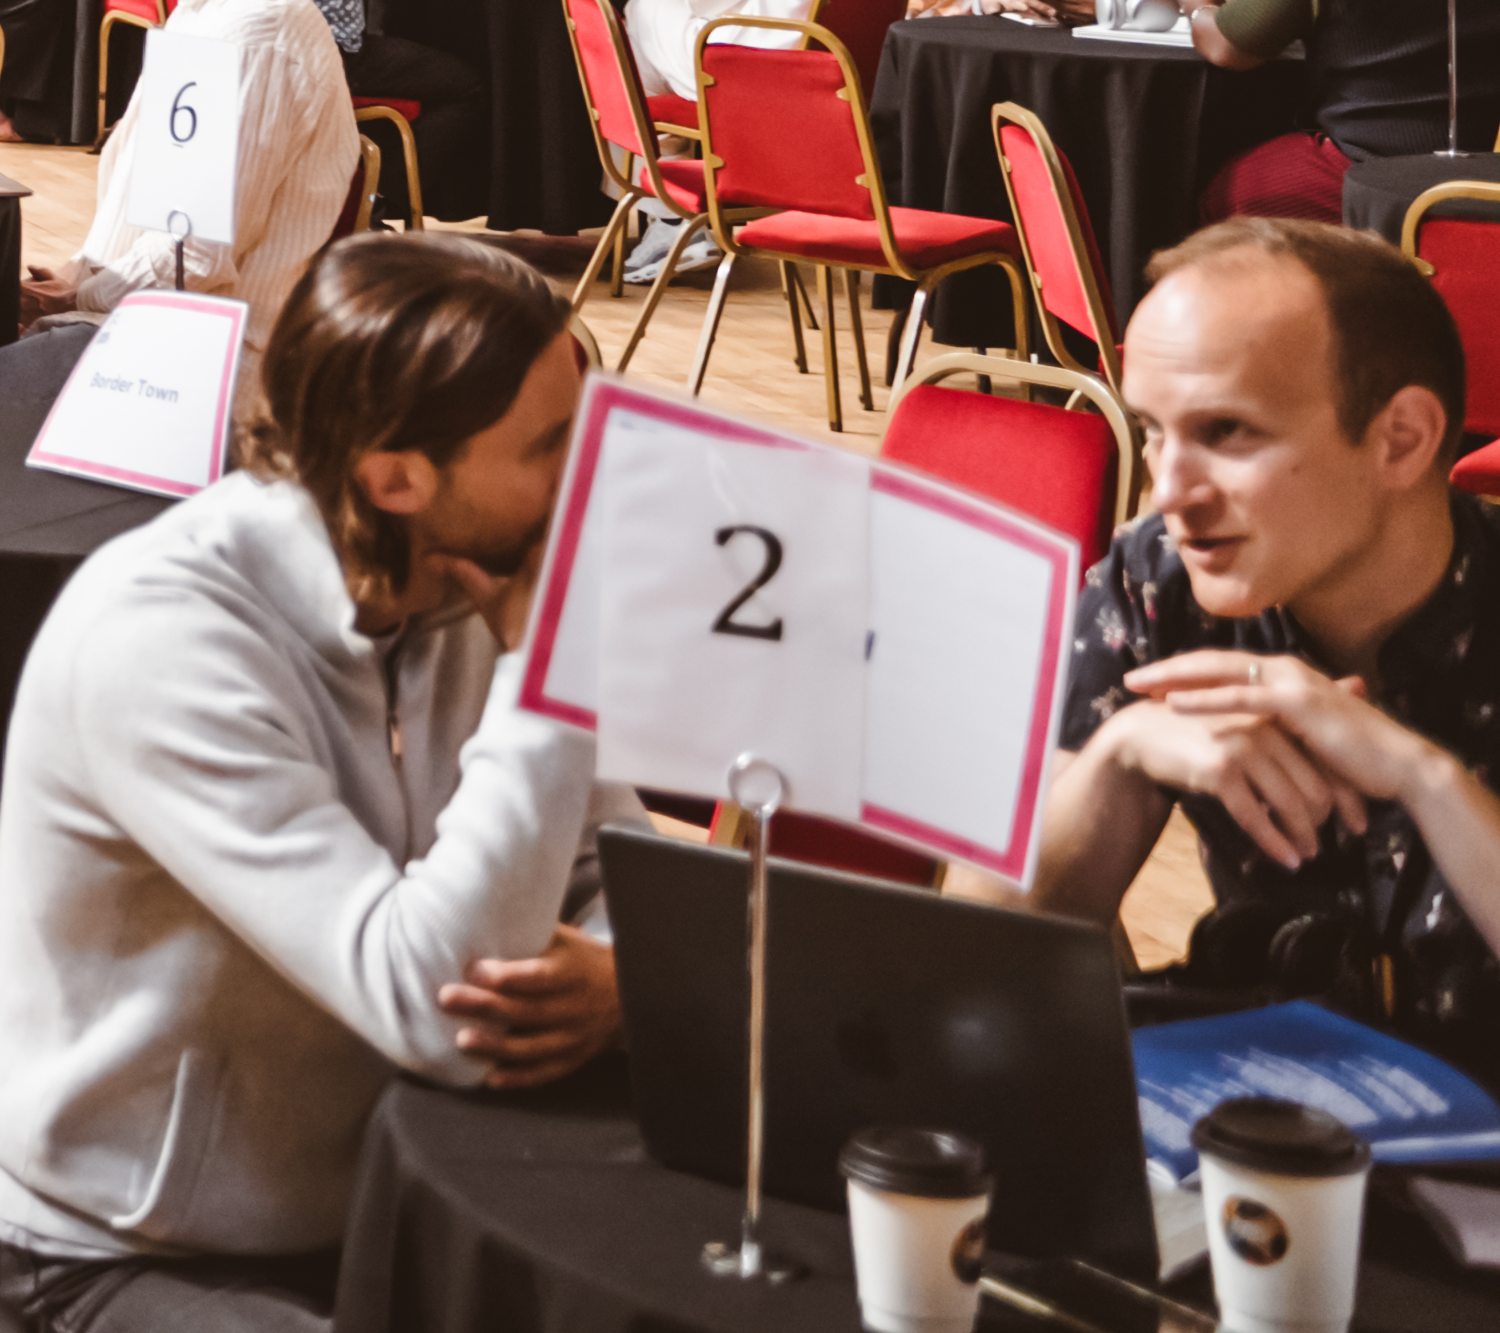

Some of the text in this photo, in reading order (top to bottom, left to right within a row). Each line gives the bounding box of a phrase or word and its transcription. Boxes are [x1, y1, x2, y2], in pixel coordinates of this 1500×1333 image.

[169, 80, 198, 144] 6
[89, 371, 180, 404] Border Town
[711, 524, 785, 642] 2
